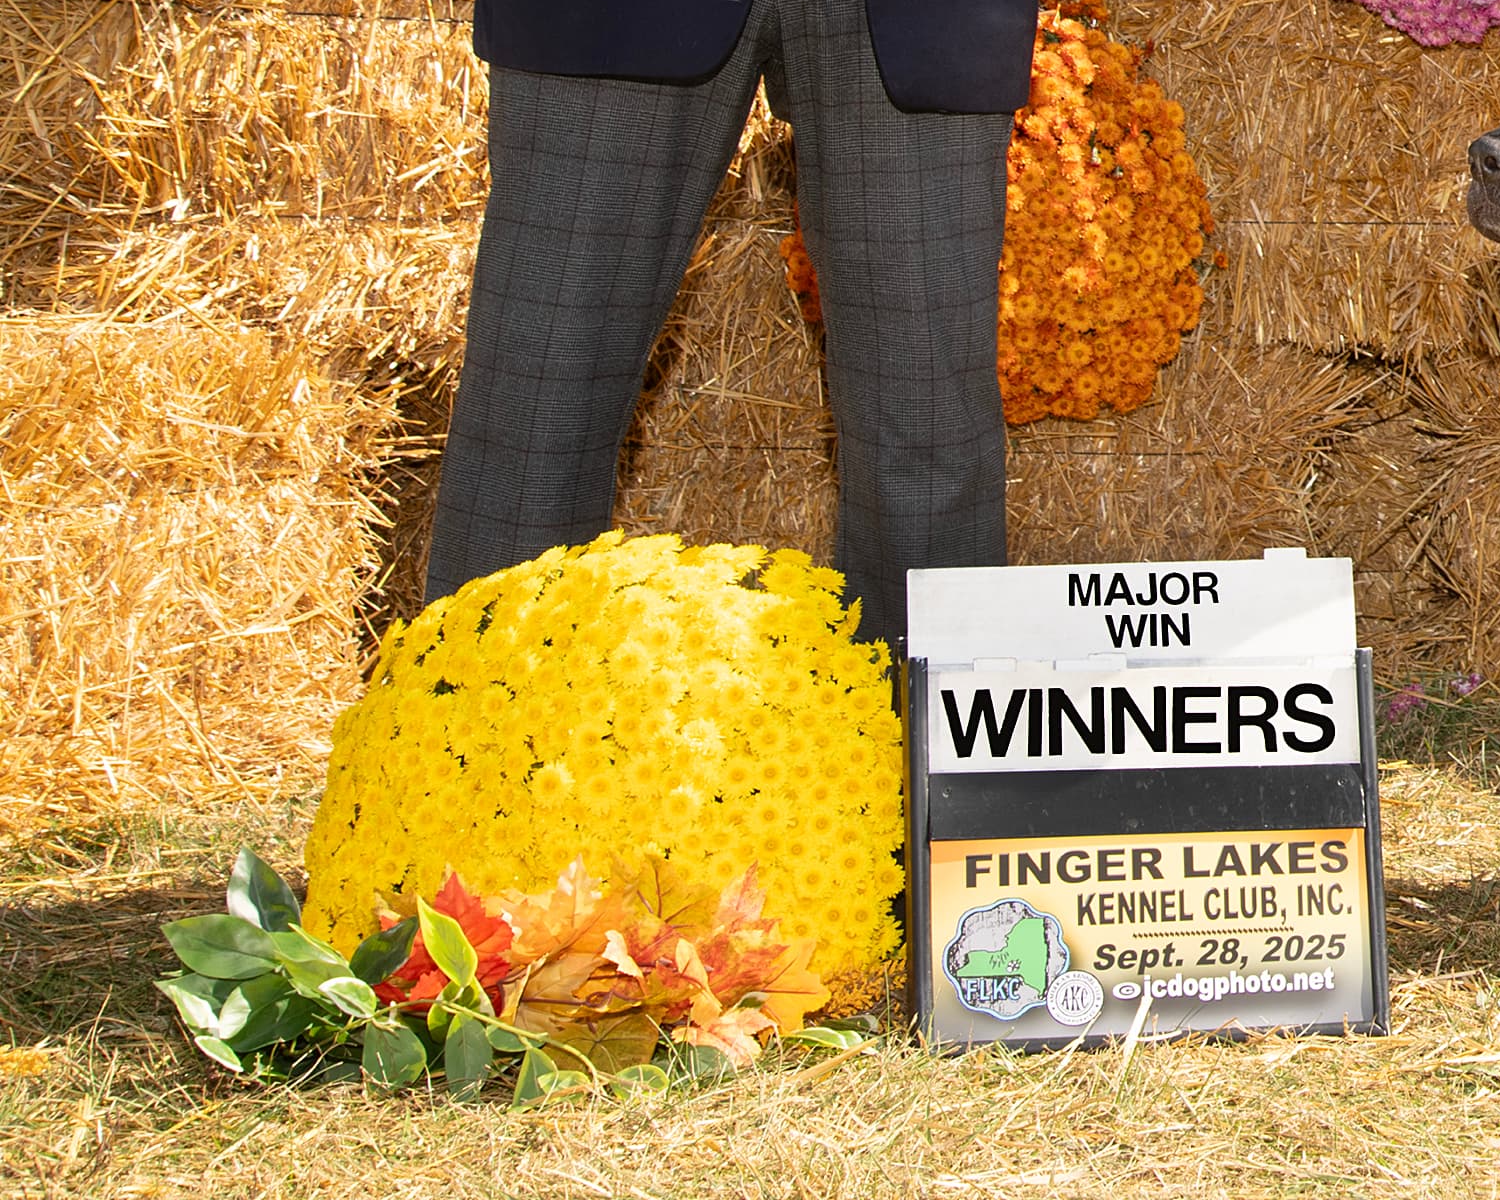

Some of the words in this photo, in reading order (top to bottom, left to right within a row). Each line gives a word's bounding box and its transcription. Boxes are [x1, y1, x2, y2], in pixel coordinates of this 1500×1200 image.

[1068, 572, 1219, 607] MAJOR
[1105, 612, 1191, 648] WIN
[941, 683, 1336, 758] WINNERS
[965, 848, 1163, 888] FINGER
[1184, 840, 1349, 878] LAKES
[1077, 889, 1194, 926] KENNEL
[1203, 885, 1287, 924] CLUB,
[1297, 882, 1353, 916] INC.
[1093, 942, 1184, 974] Sept.
[1197, 938, 1249, 969] 28,
[1261, 934, 1347, 962] 2025
[966, 978, 1020, 1000] FLKC
[1061, 985, 1089, 1011] AKC
